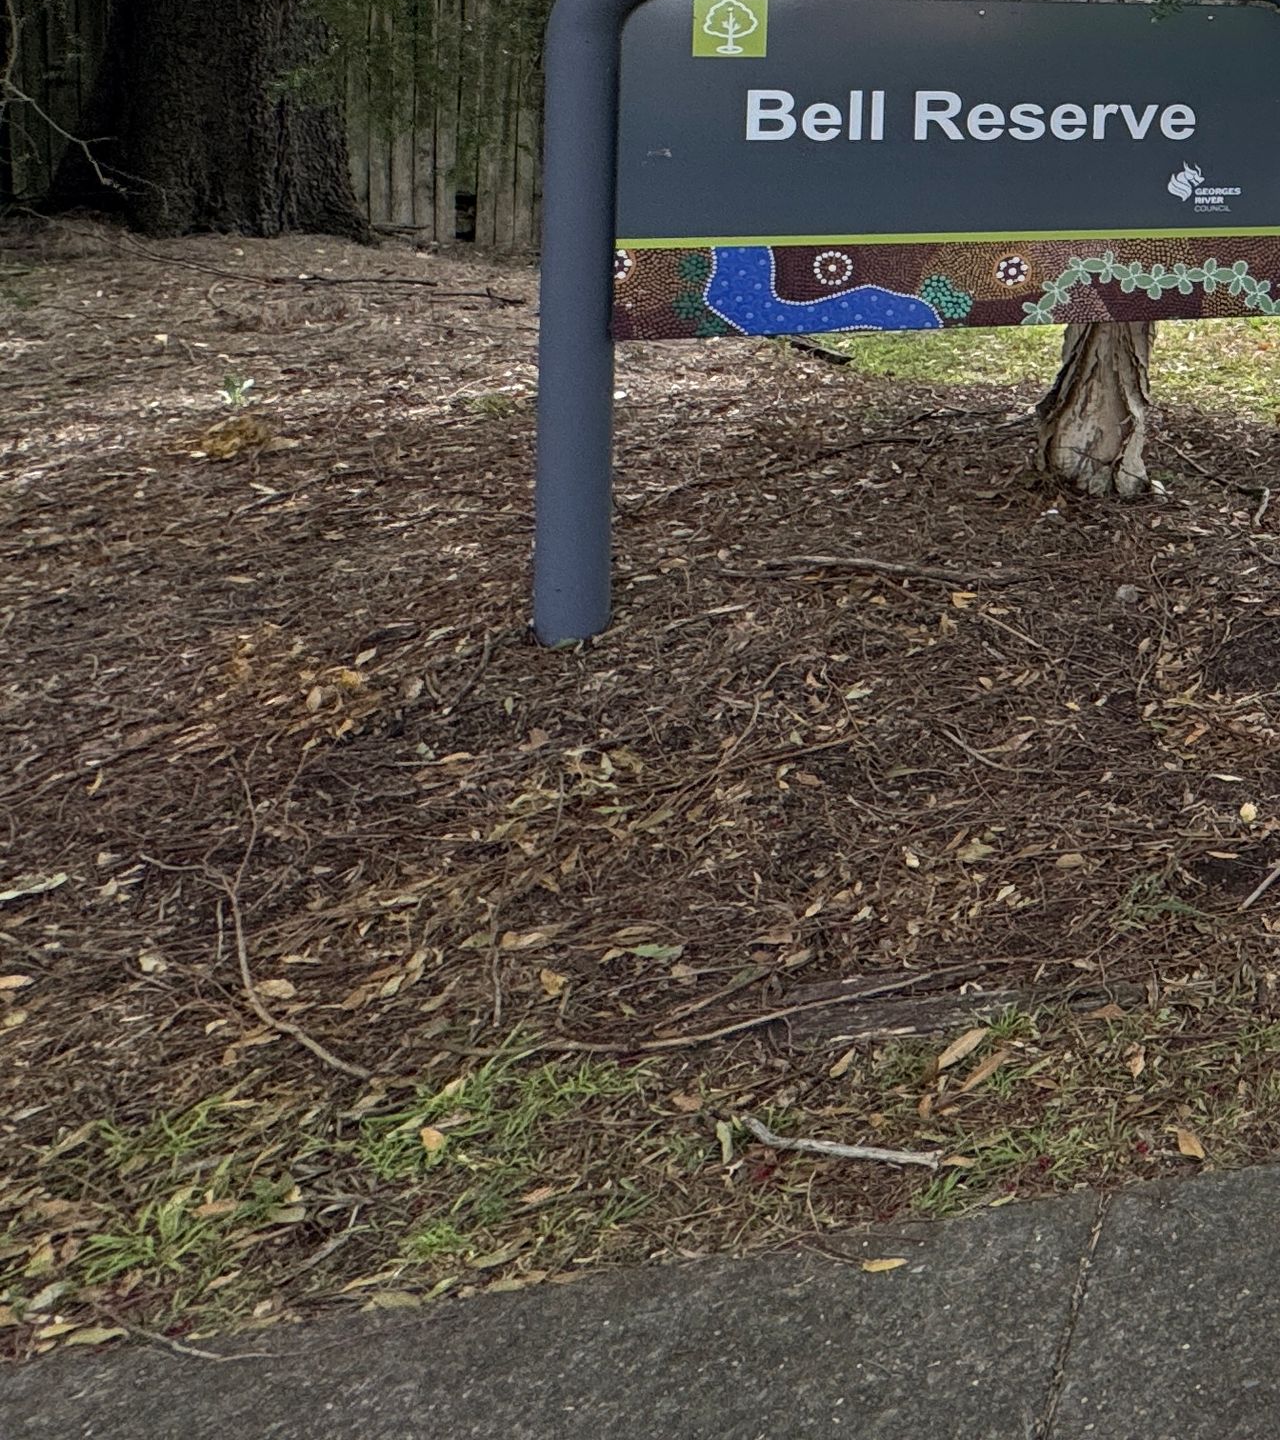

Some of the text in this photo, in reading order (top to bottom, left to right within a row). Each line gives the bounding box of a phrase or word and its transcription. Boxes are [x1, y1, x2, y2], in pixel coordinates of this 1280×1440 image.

[745, 89, 1197, 141] Bell Reserve
[1194, 187, 1242, 196] GEORGES
[1194, 196, 1224, 204] RIVER
[1194, 205, 1231, 213] COUNCIL
